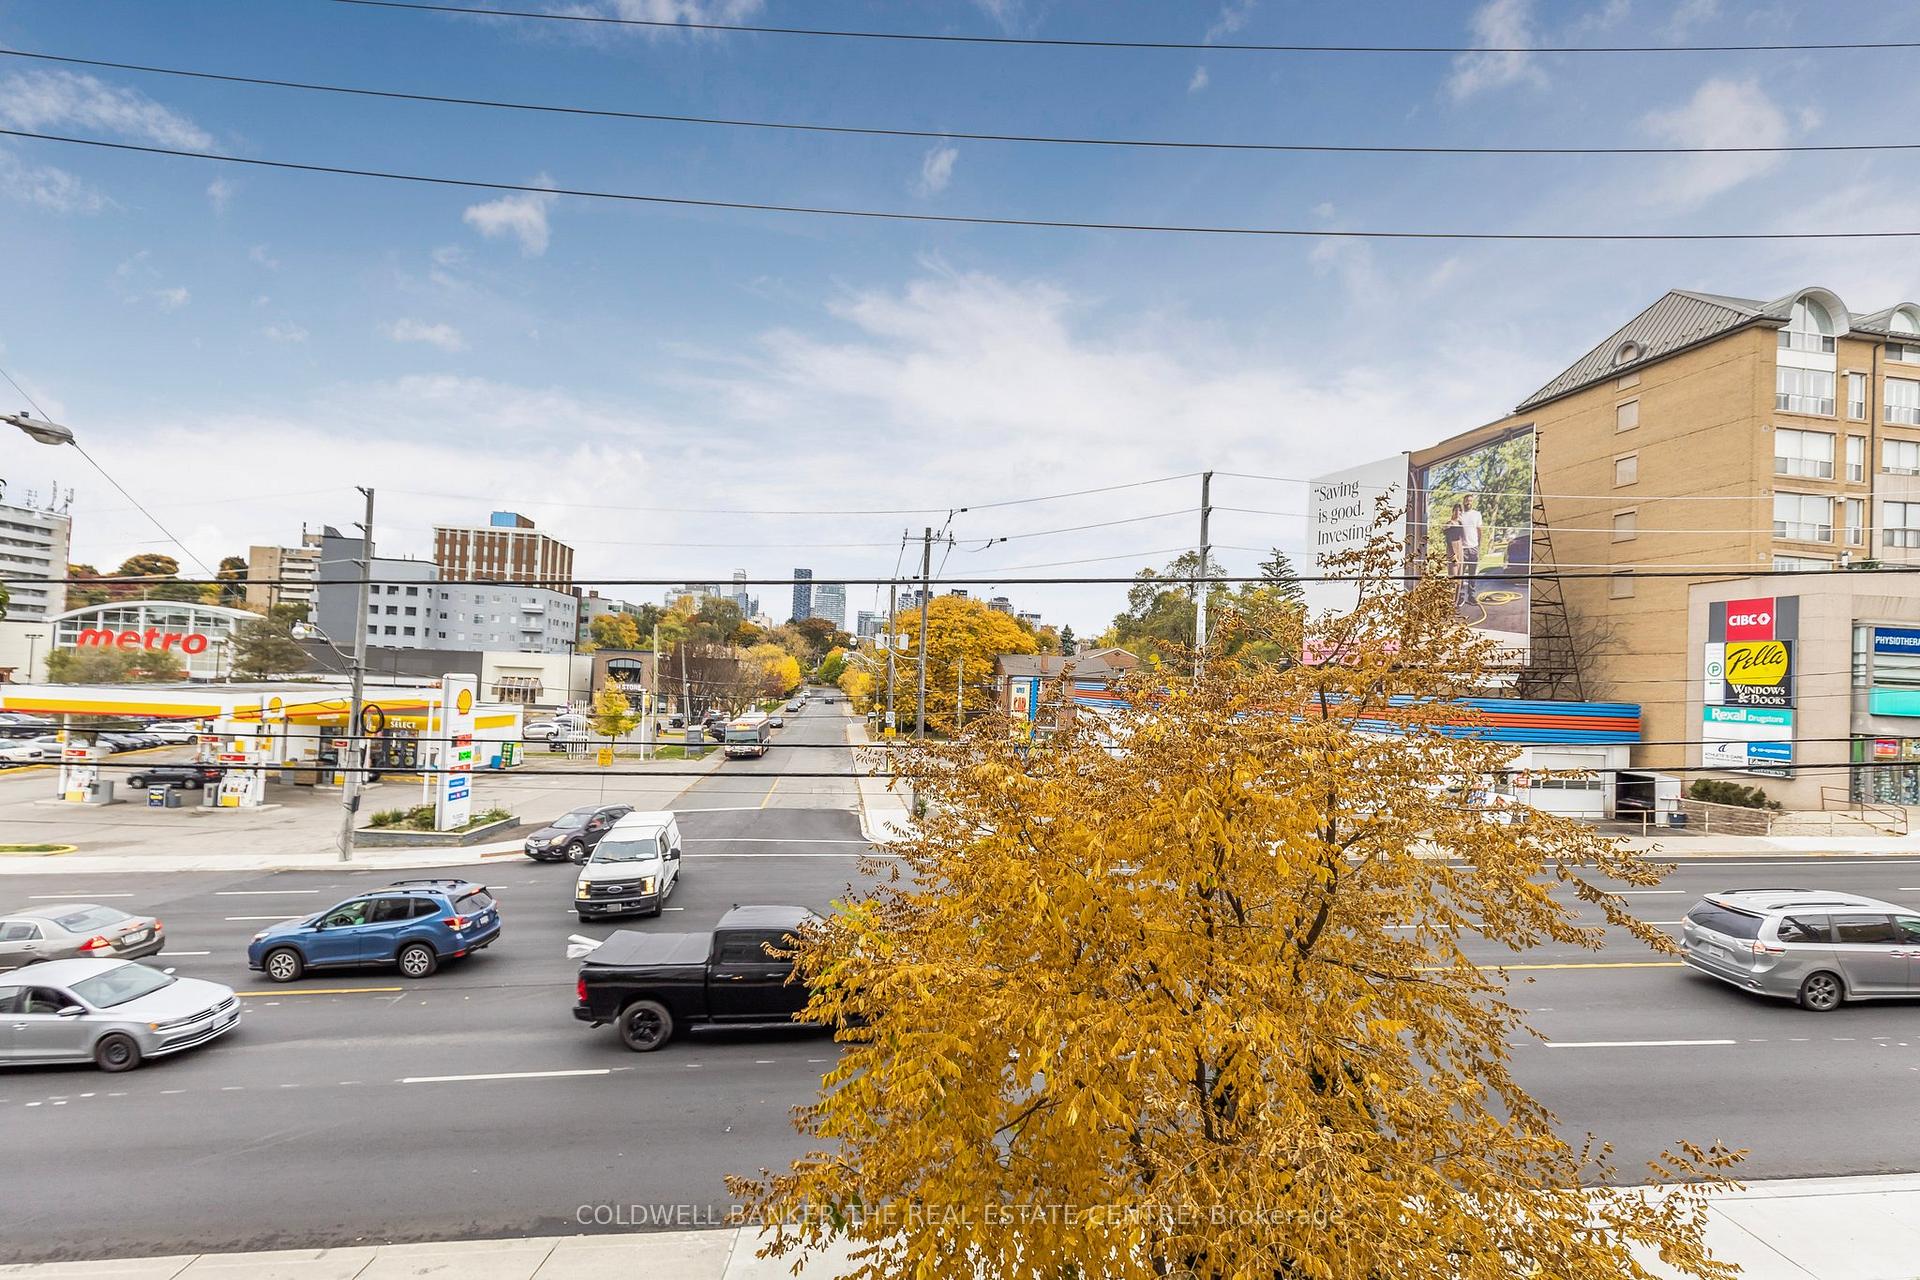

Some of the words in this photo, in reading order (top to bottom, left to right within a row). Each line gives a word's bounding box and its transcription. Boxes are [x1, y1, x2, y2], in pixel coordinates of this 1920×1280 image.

[1318, 508, 1328, 524] is
[1330, 499, 1365, 525] good.
[1317, 523, 1374, 546] Investing
[1728, 614, 1758, 627] CIBC
[76, 626, 209, 655] metro
[1727, 644, 1784, 676] Pella
[1731, 684, 1786, 696] WINDOWS
[1750, 694, 1786, 705] DOORS
[1711, 707, 1747, 721] Rexall
[1747, 714, 1785, 724] Drugstore
[390, 720, 417, 730] SELECT
